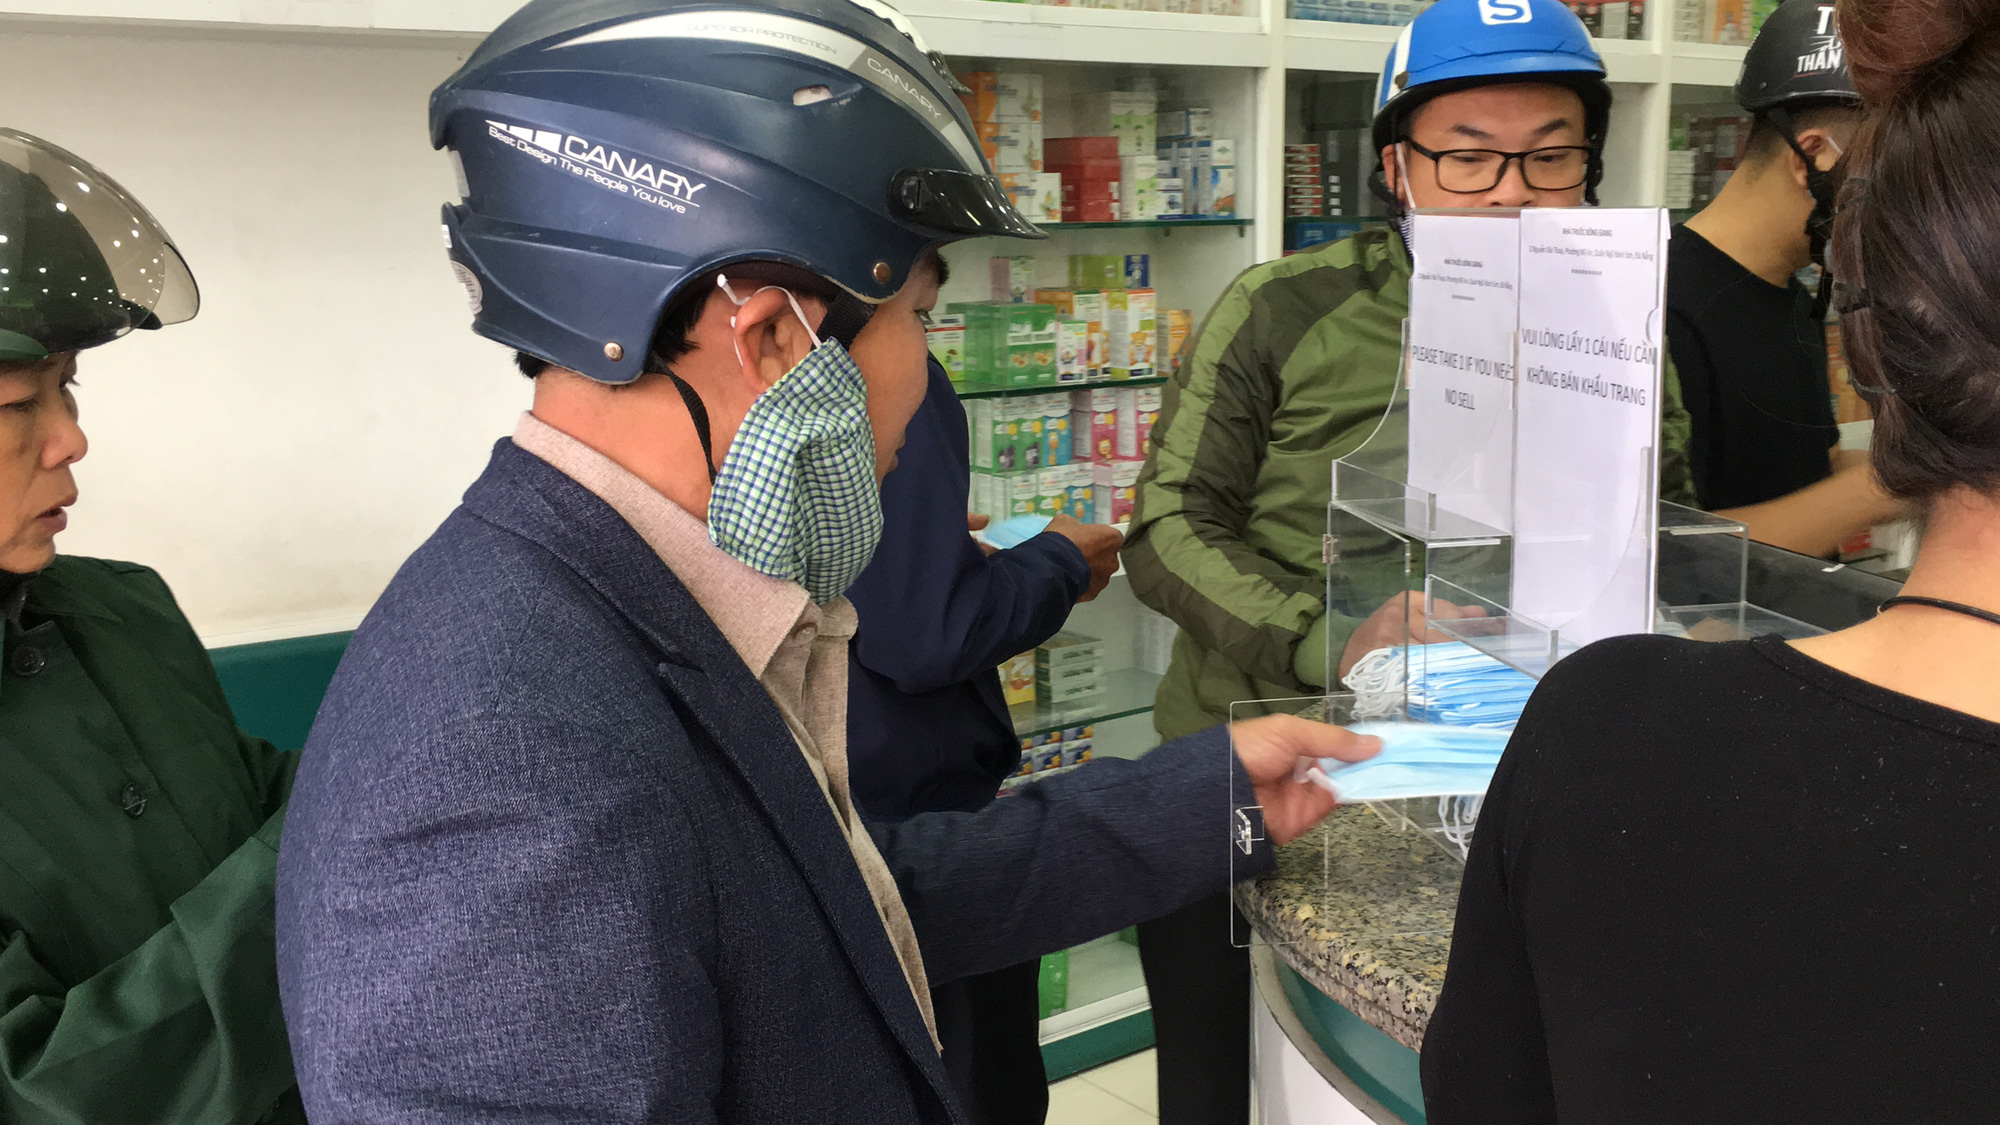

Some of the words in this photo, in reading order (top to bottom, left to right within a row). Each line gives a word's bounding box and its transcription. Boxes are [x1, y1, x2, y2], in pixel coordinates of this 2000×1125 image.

[687, 23, 754, 34] SUPERIOR
[756, 28, 837, 55] PROTECTION
[867, 57, 942, 118] CANARY
[488, 125, 516, 147] Best
[516, 141, 558, 166] Design
[559, 156, 584, 176] The
[584, 169, 628, 194] People
[631, 184, 658, 204] You
[657, 195, 686, 214] love
[564, 134, 706, 200] CANARY
[1521, 328, 1538, 345] VUI
[1539, 327, 1565, 350] LÒNG
[1585, 338, 1590, 354] 1
[1592, 336, 1609, 357] CÁI
[1412, 345, 1438, 364] PLEASE
[1439, 350, 1458, 369] TAKE
[1459, 354, 1464, 371] 1
[1465, 356, 1473, 371] IF
[1474, 358, 1493, 376] YOU
[1444, 388, 1457, 406] NO
[1458, 391, 1475, 411] SELL
[1527, 365, 1559, 388] KHÔNG
[1560, 370, 1579, 392] BÁN
[1610, 383, 1646, 406] TRANG
